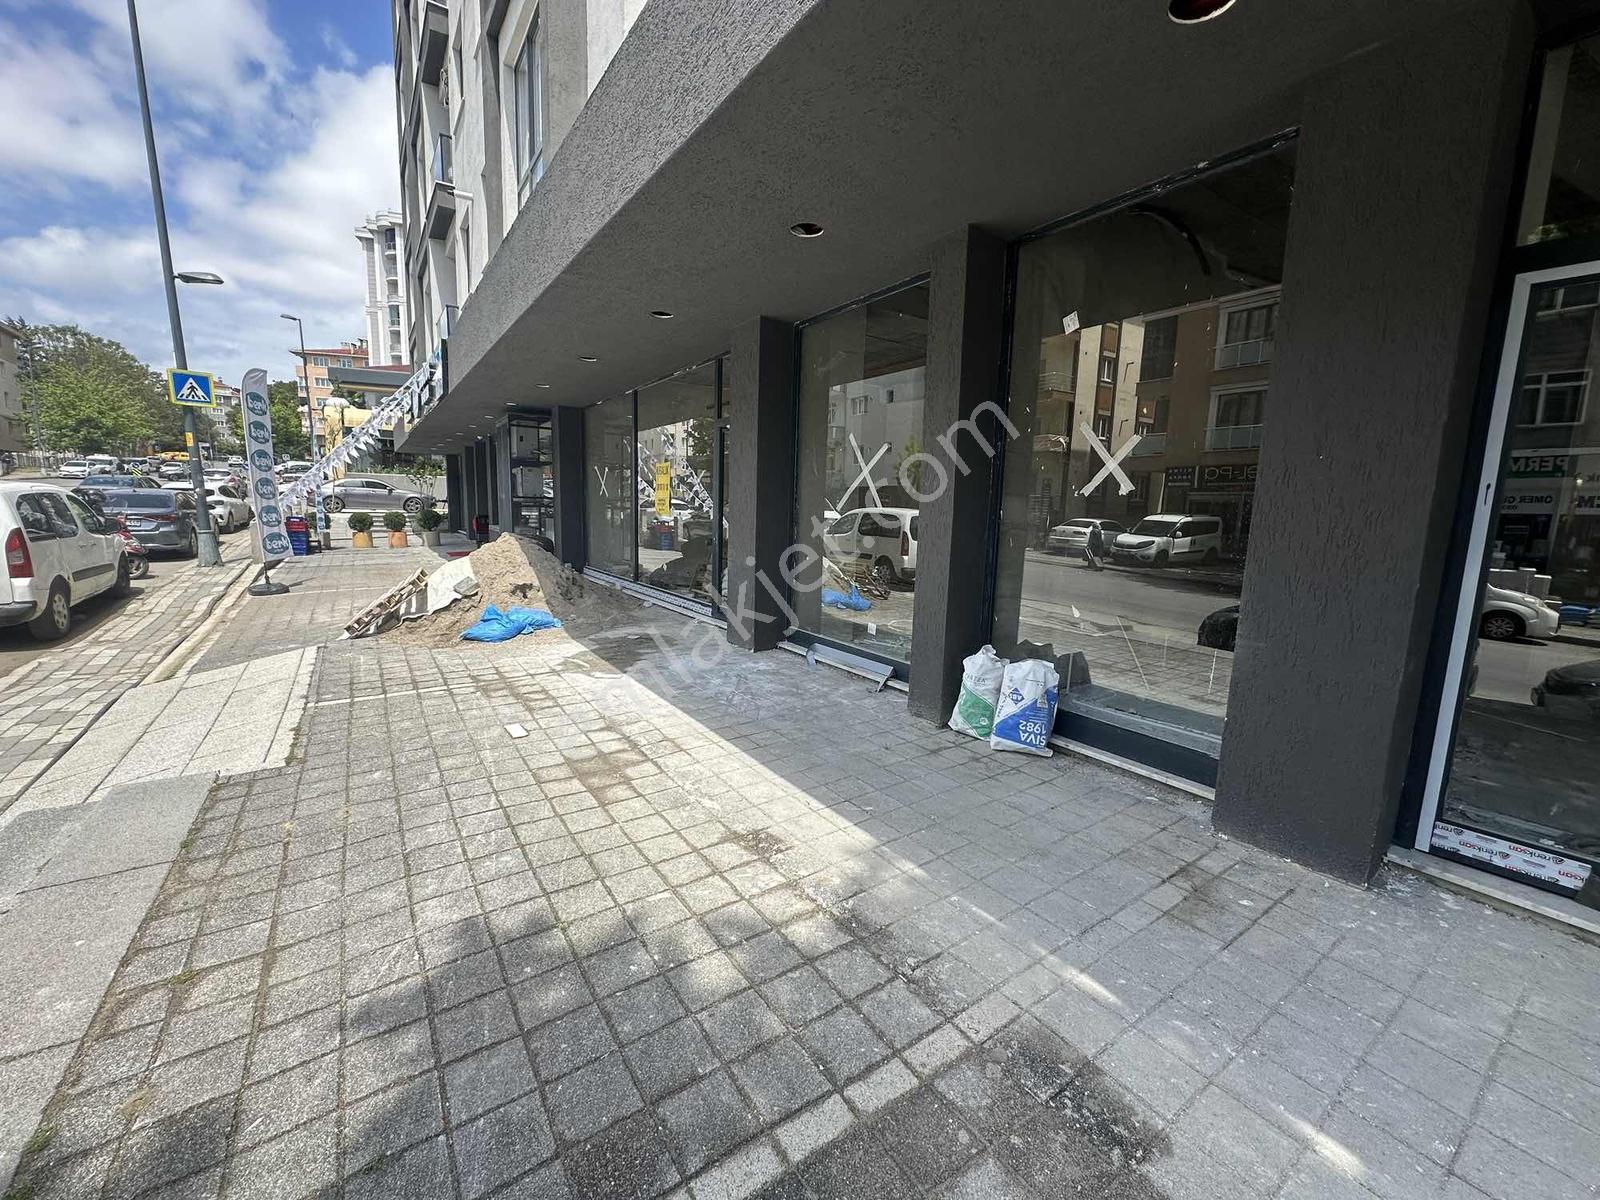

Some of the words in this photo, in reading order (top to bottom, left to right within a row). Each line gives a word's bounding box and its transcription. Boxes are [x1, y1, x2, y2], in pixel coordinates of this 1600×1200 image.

[265, 535, 289, 550] berk
[1019, 720, 1047, 735] 1982
[1019, 730, 1047, 746] SIVA
[1458, 839, 1498, 858] renksan
[1508, 843, 1552, 862] renksan
